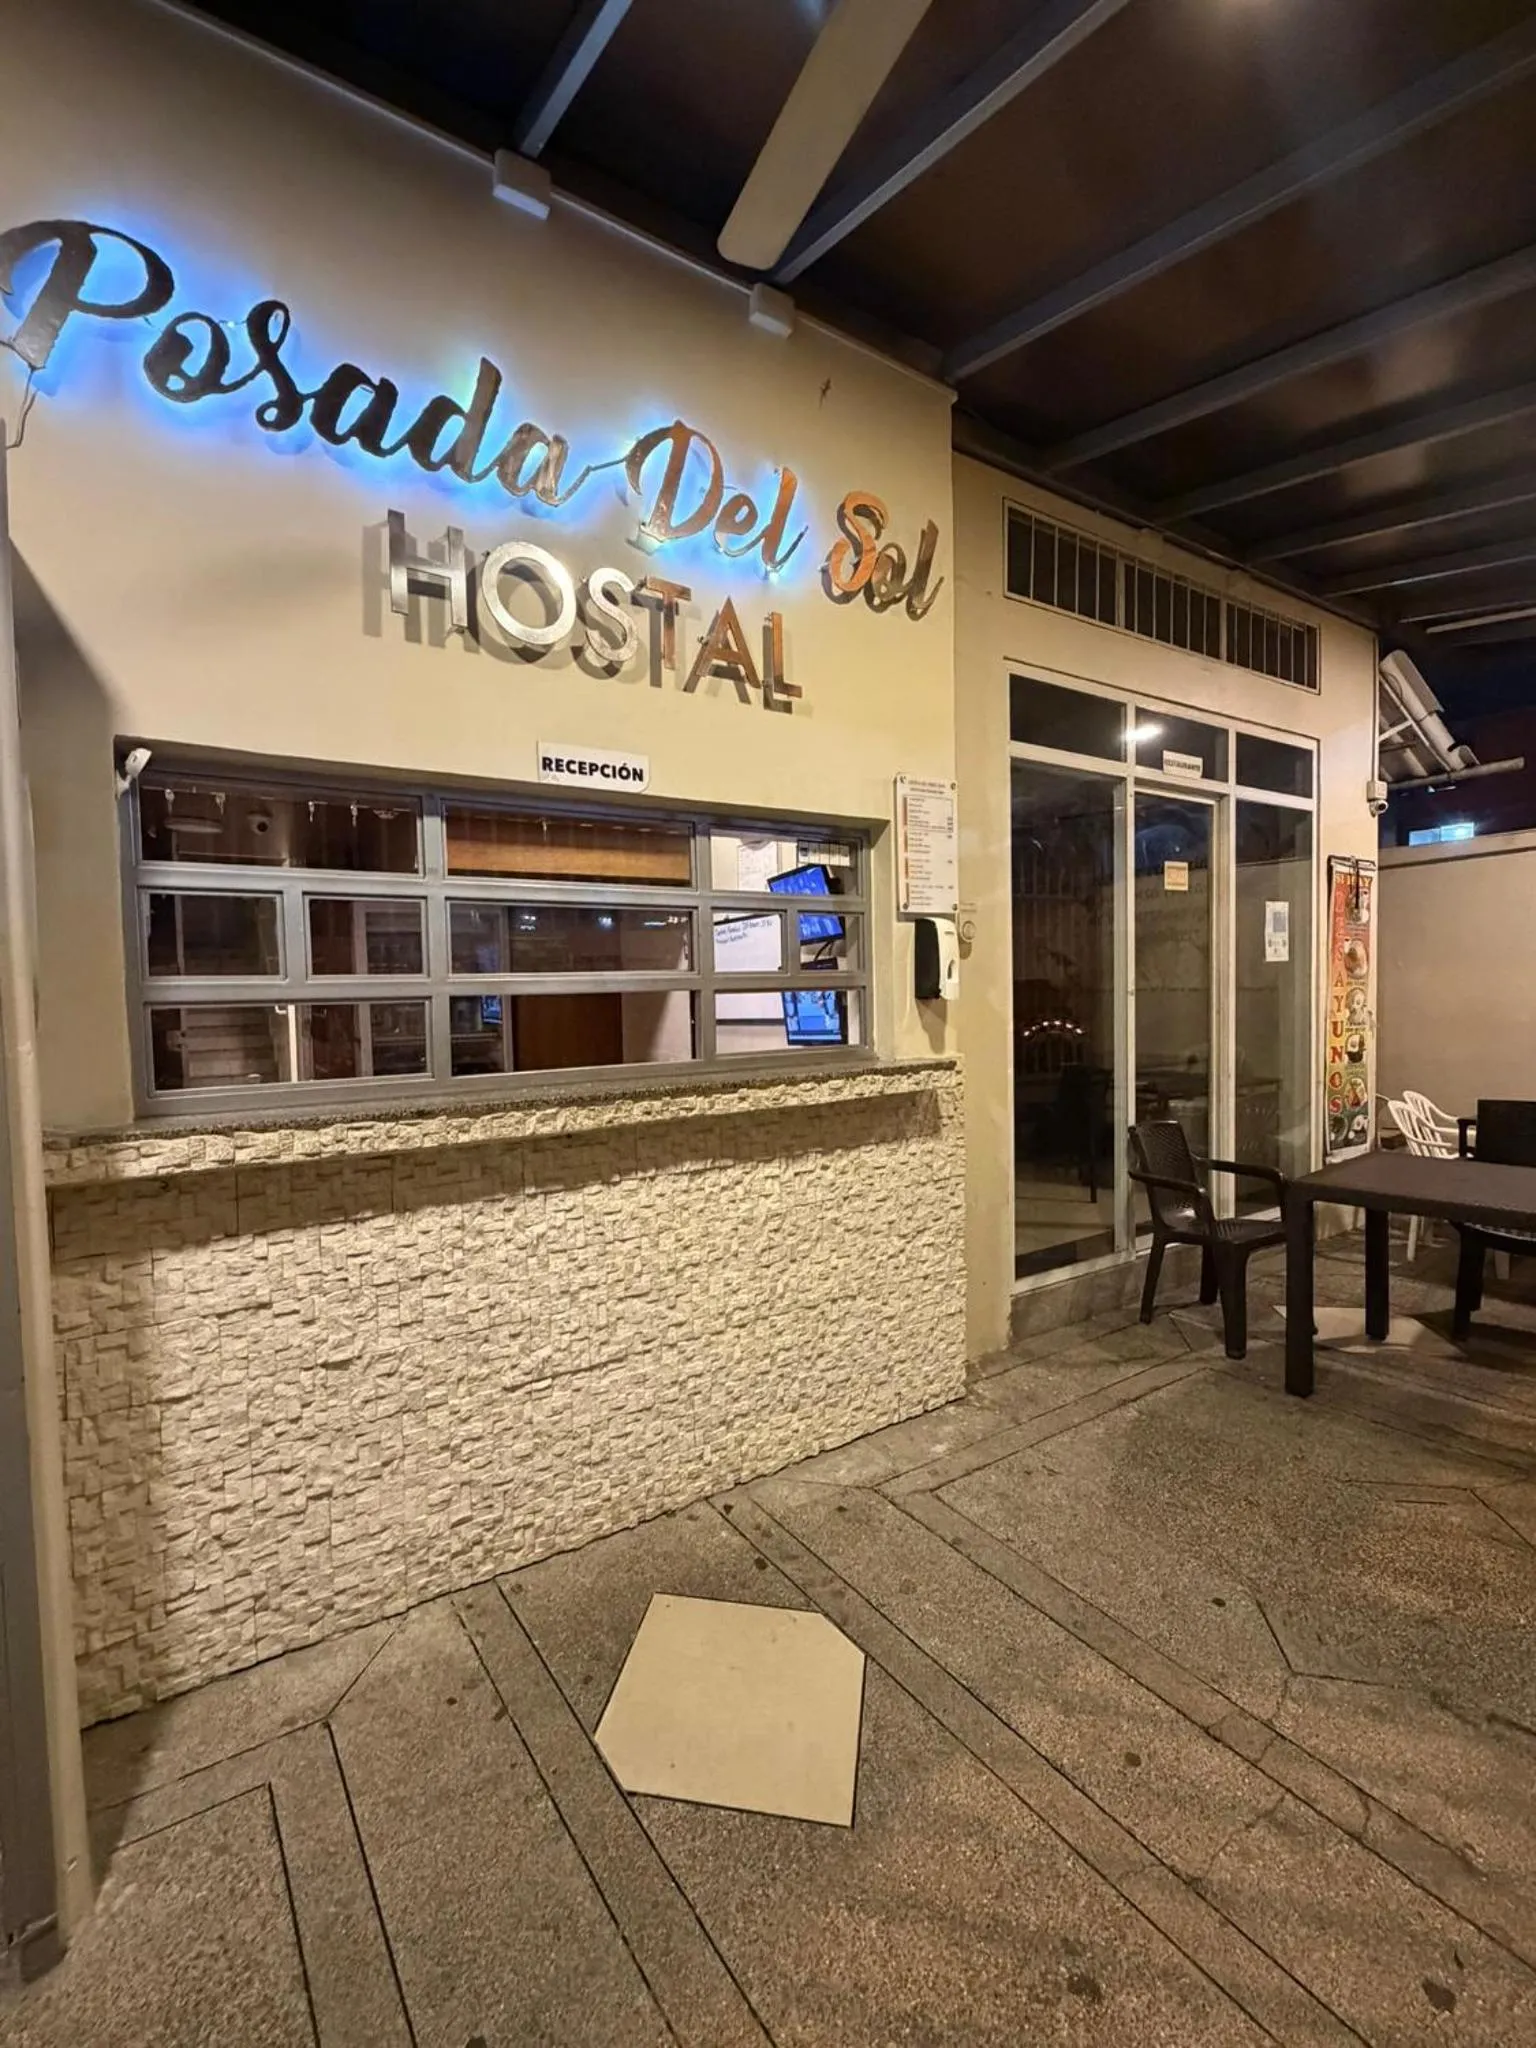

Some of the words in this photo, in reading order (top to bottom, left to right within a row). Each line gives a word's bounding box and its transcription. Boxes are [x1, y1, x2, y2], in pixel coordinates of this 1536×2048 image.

[0, 219, 594, 506] Posada
[625, 419, 809, 569] Del
[822, 490, 945, 621] Sol
[387, 508, 803, 703] HOSTAL
[541, 755, 645, 782] RECEPCIÓN
